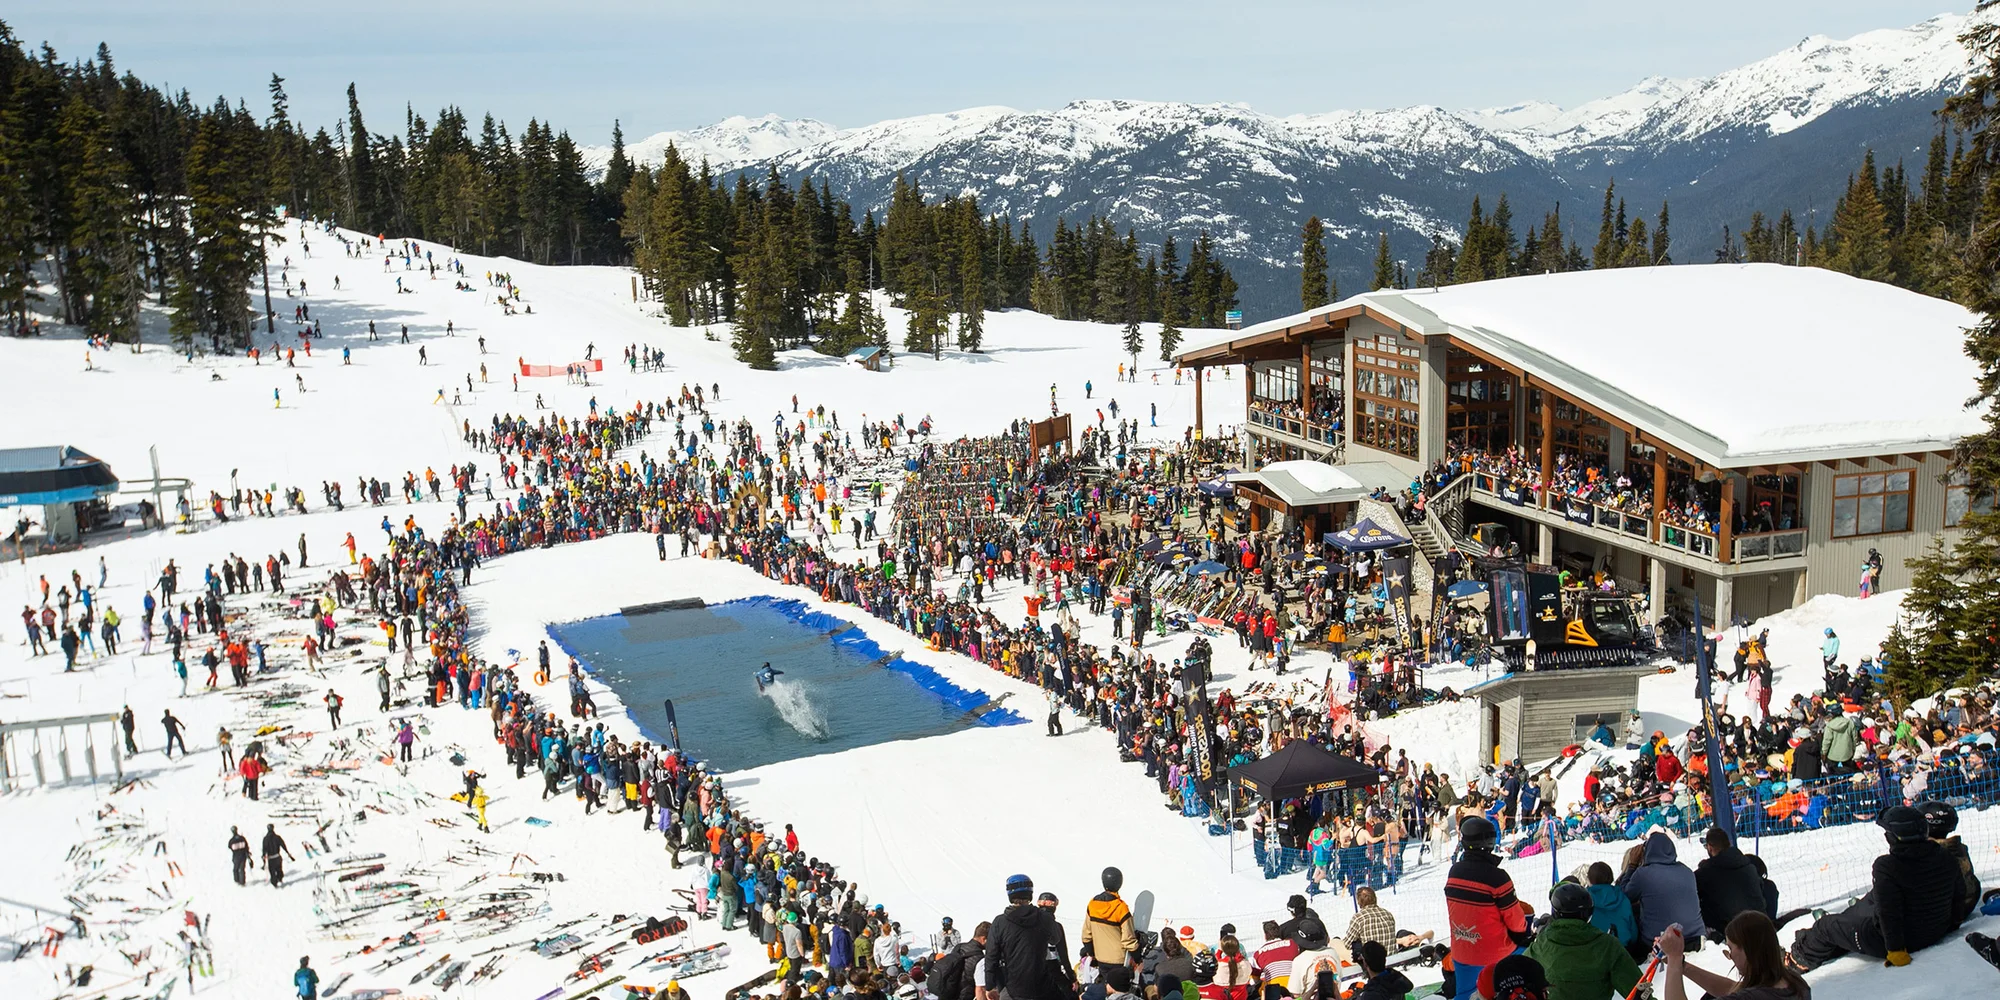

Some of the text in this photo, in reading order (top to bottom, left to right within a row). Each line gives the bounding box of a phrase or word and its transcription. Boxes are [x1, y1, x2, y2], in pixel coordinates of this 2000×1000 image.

[1360, 534, 1393, 543] Corona
[1431, 594, 1443, 644] ROCKSTAR
[1316, 780, 1347, 790] ROCKSTAR
[638, 920, 687, 945] NITRO
